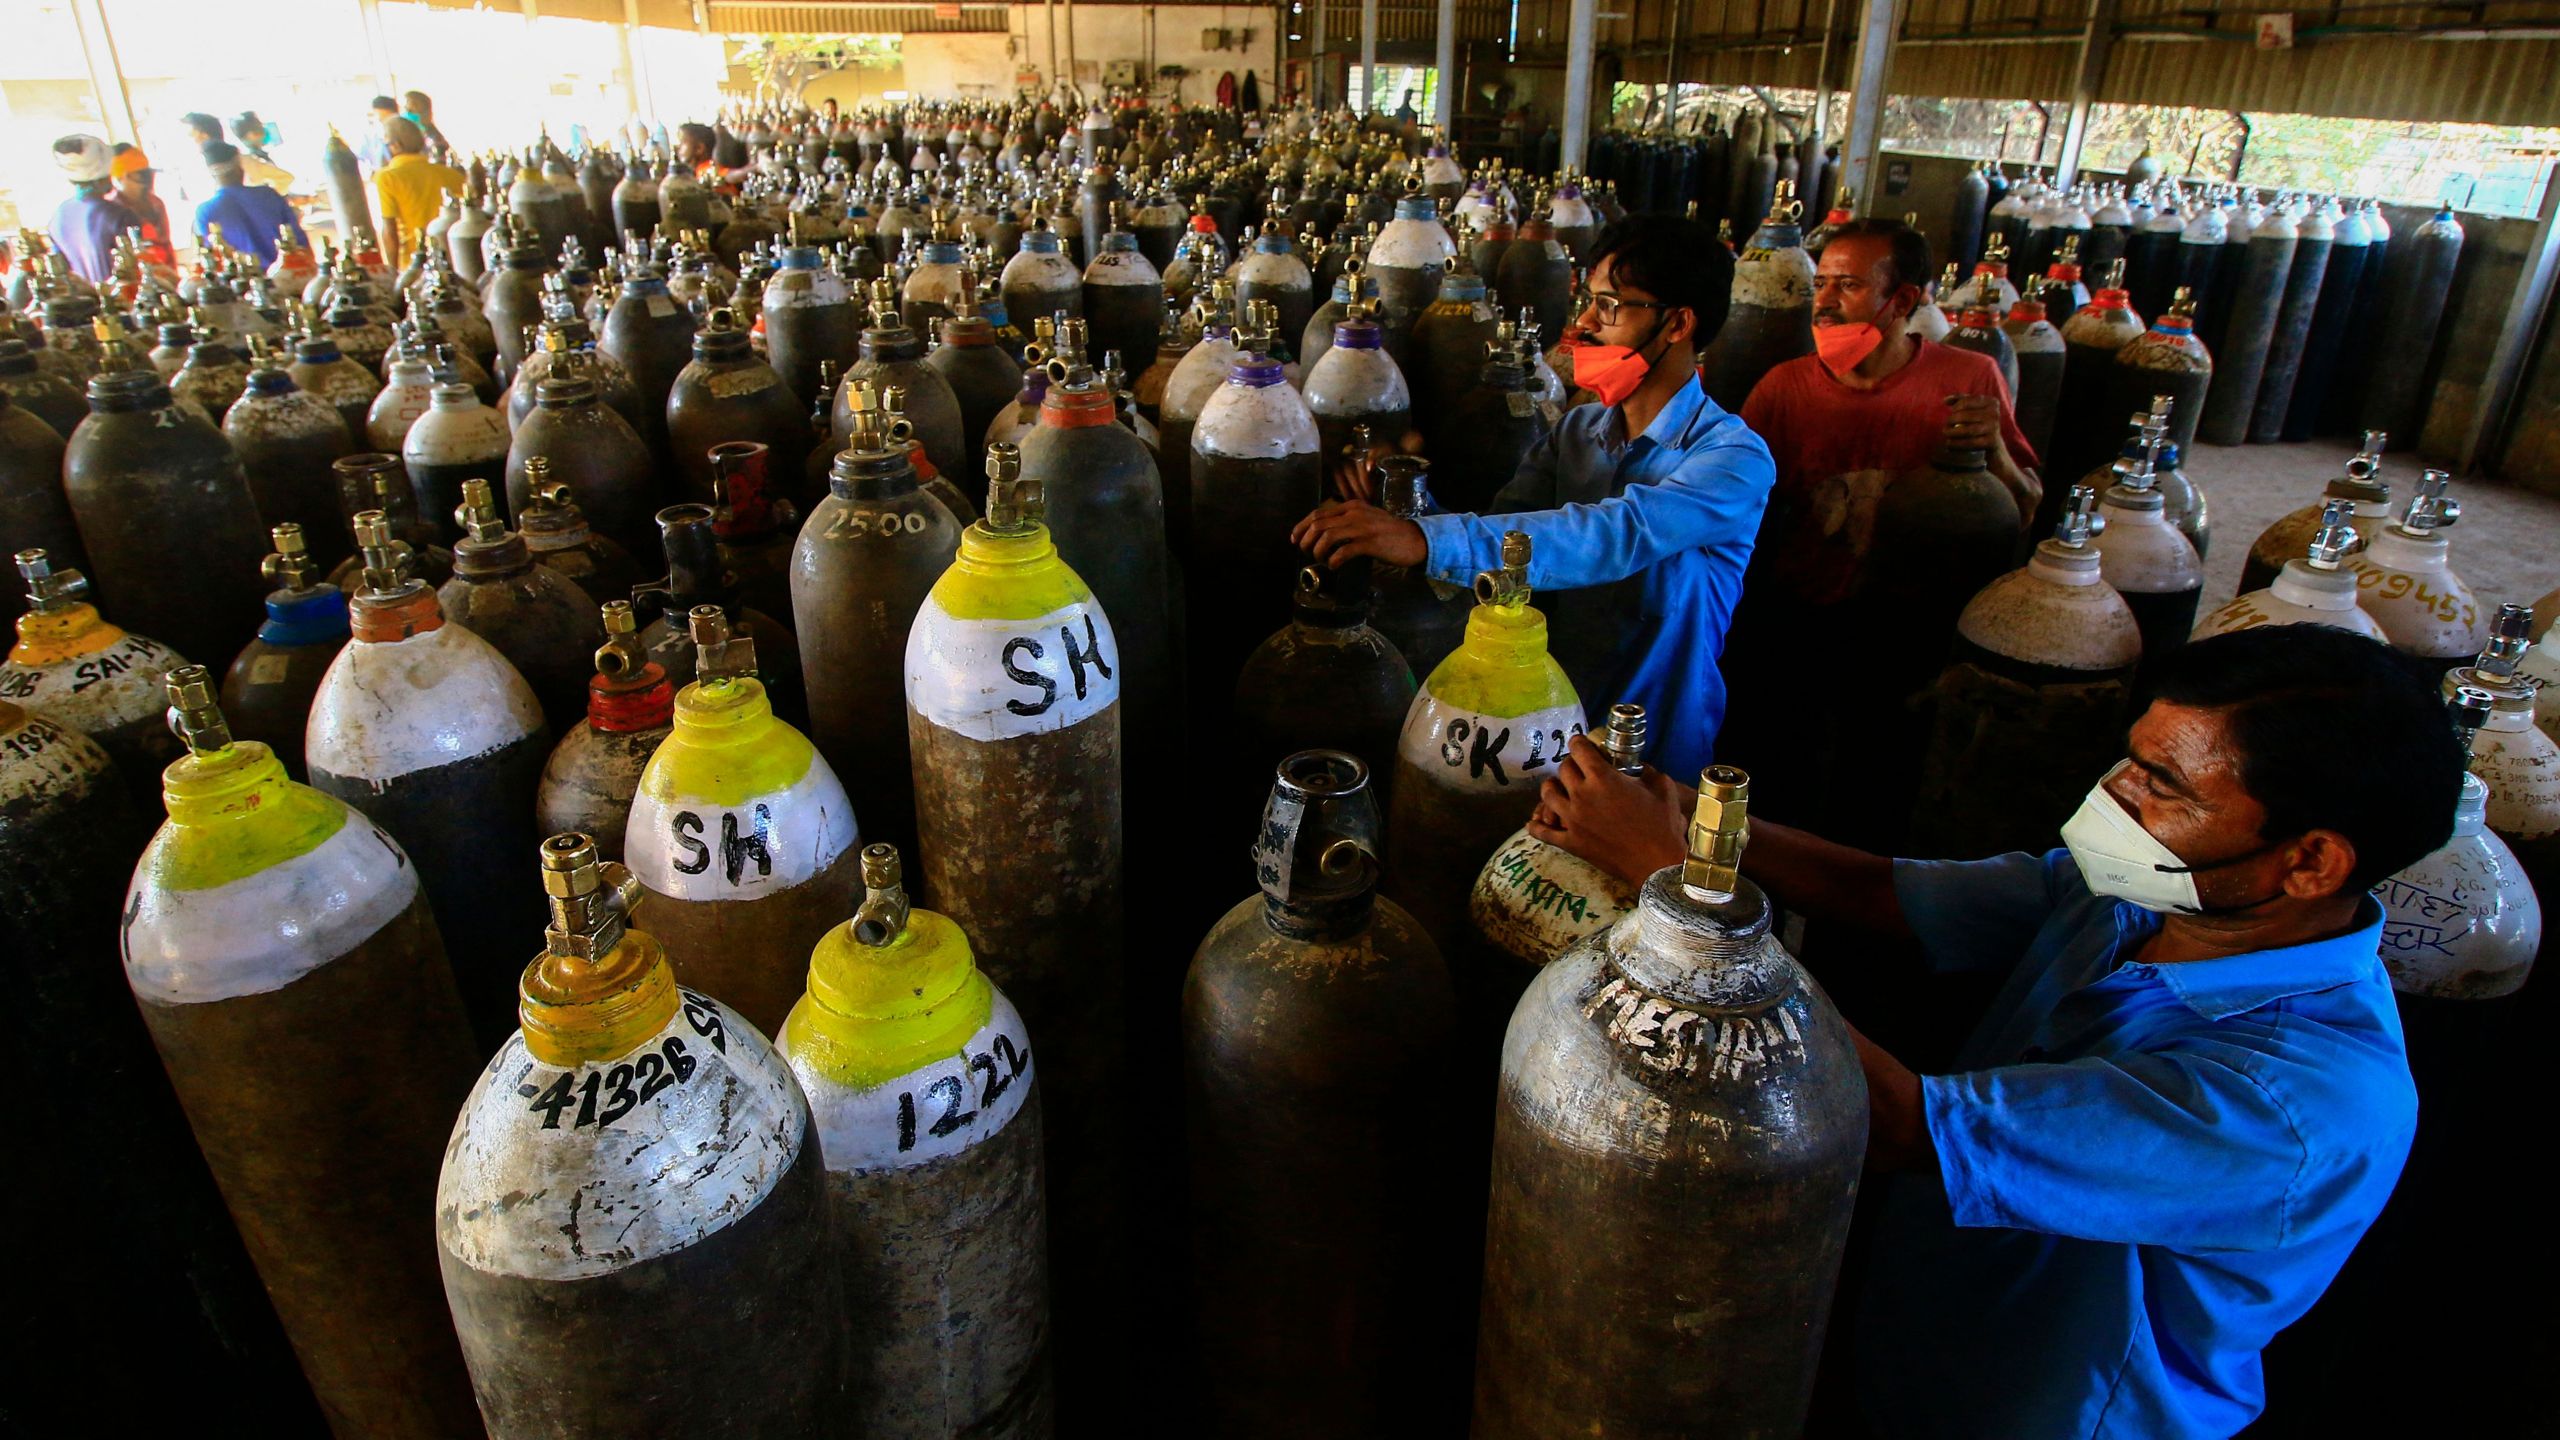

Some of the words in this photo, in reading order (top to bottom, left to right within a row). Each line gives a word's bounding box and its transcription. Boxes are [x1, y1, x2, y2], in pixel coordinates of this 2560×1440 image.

[823, 508, 926, 540] 2500
[1441, 718, 1510, 786] SK
[897, 1033, 1029, 1152] 1222
